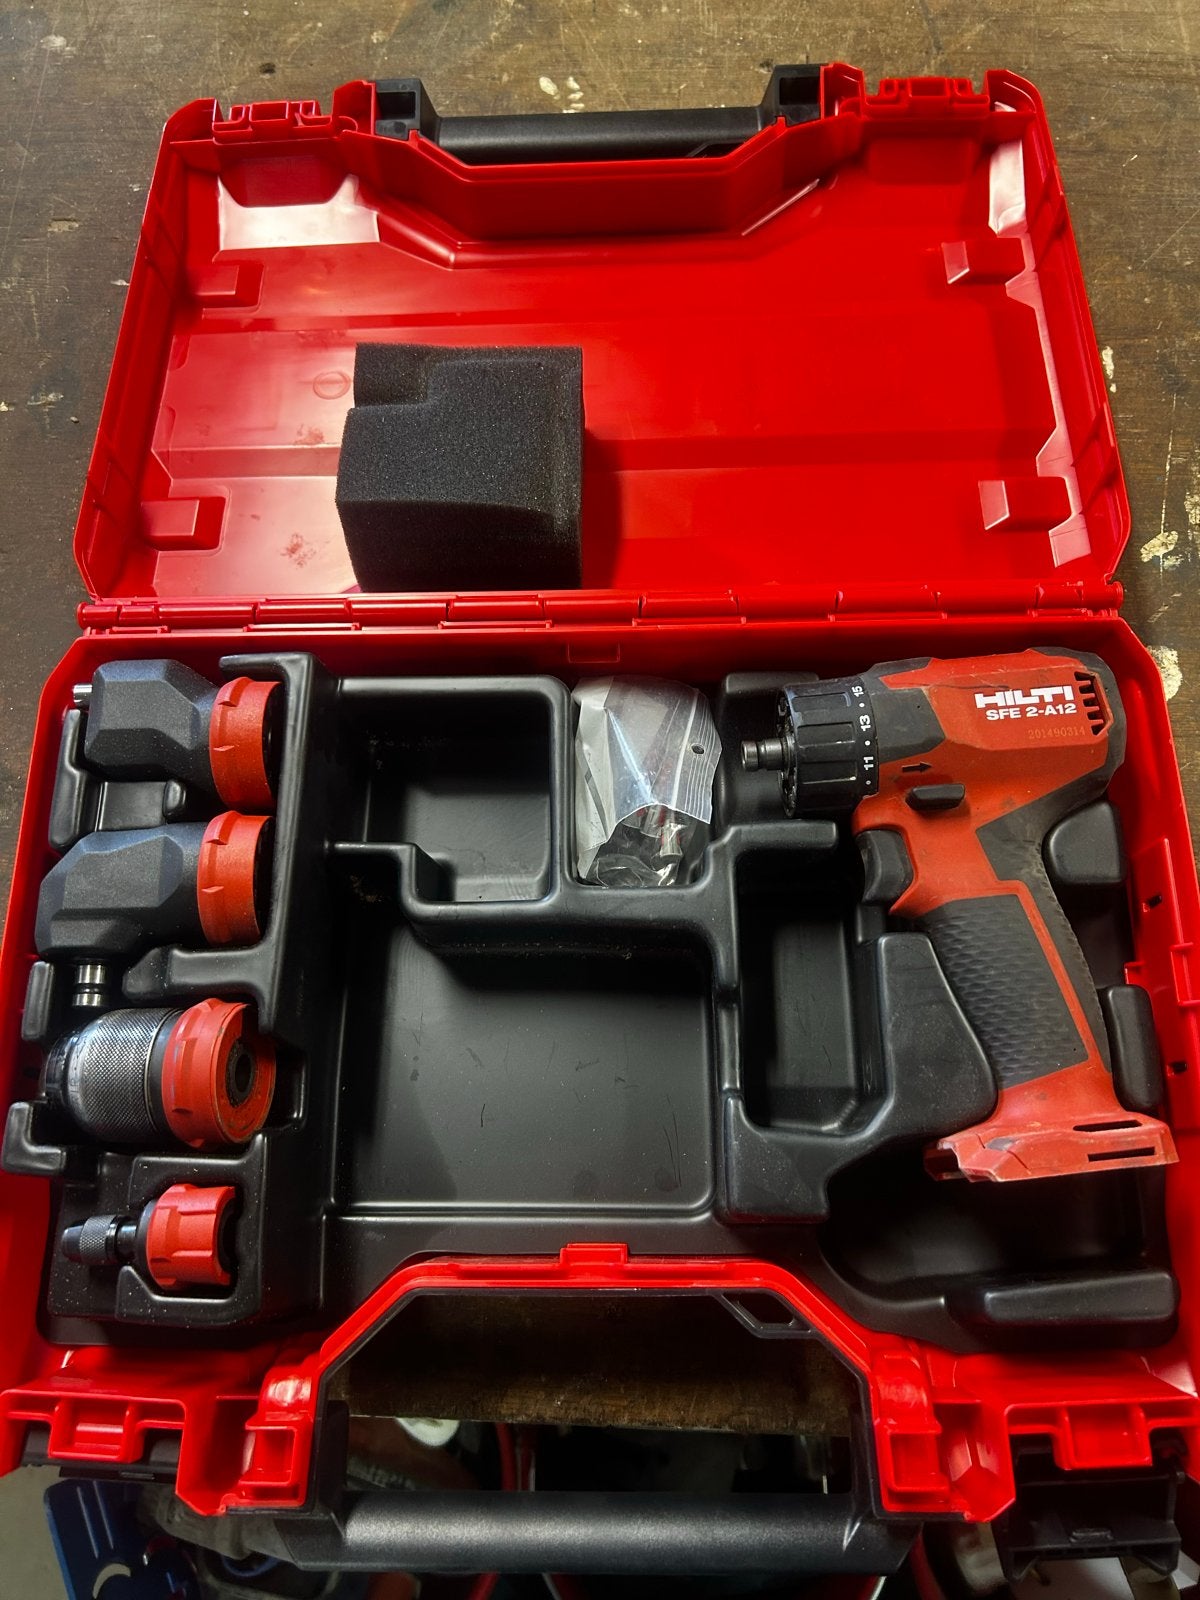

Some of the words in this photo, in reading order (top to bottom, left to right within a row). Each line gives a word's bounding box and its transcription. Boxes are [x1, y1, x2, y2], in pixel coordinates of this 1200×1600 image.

[851, 685, 865, 698] 15
[974, 685, 1075, 709] HILTI
[985, 707, 1022, 721] SFE
[1025, 703, 1077, 718] 2-A12
[859, 714, 872, 732] 13
[863, 756, 874, 771] 11
